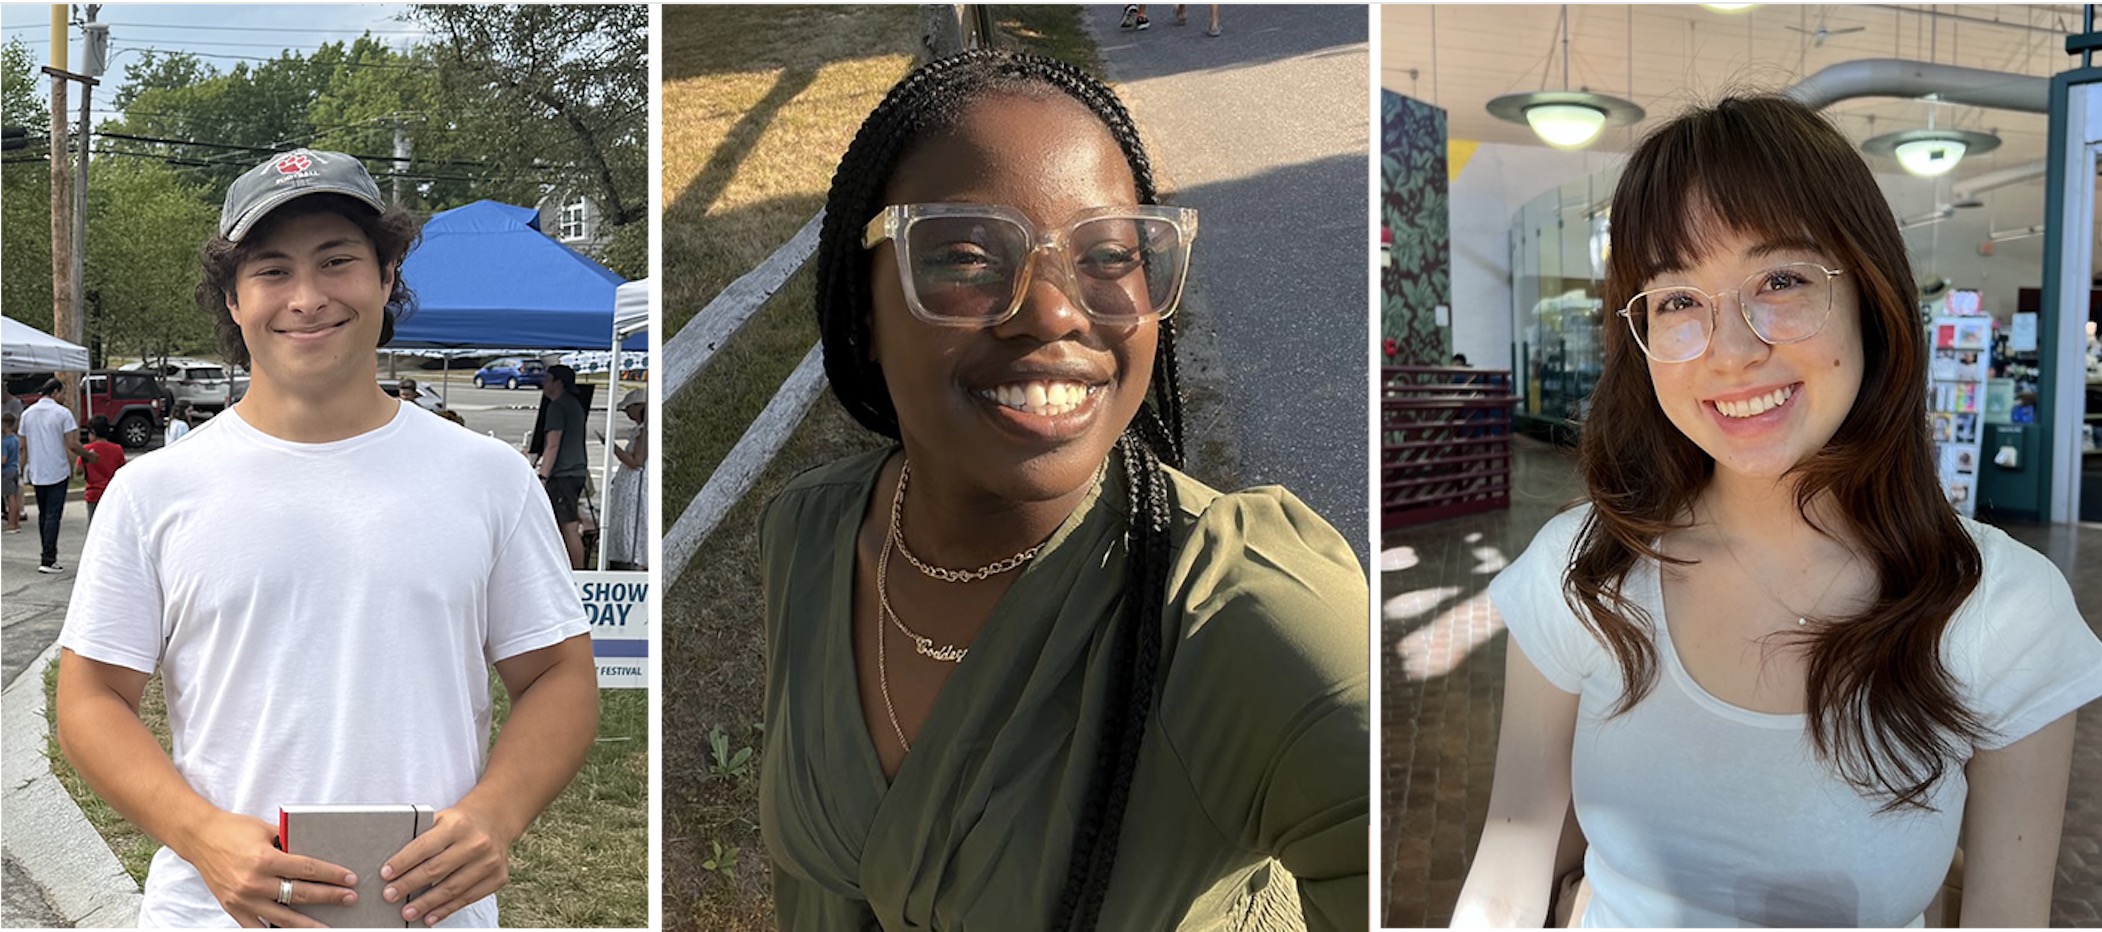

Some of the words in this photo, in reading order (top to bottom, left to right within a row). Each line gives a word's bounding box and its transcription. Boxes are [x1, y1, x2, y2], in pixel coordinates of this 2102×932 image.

[582, 583, 648, 602] SHOW
[585, 604, 632, 626] DAY
[600, 666, 642, 676] FESTIVAL
